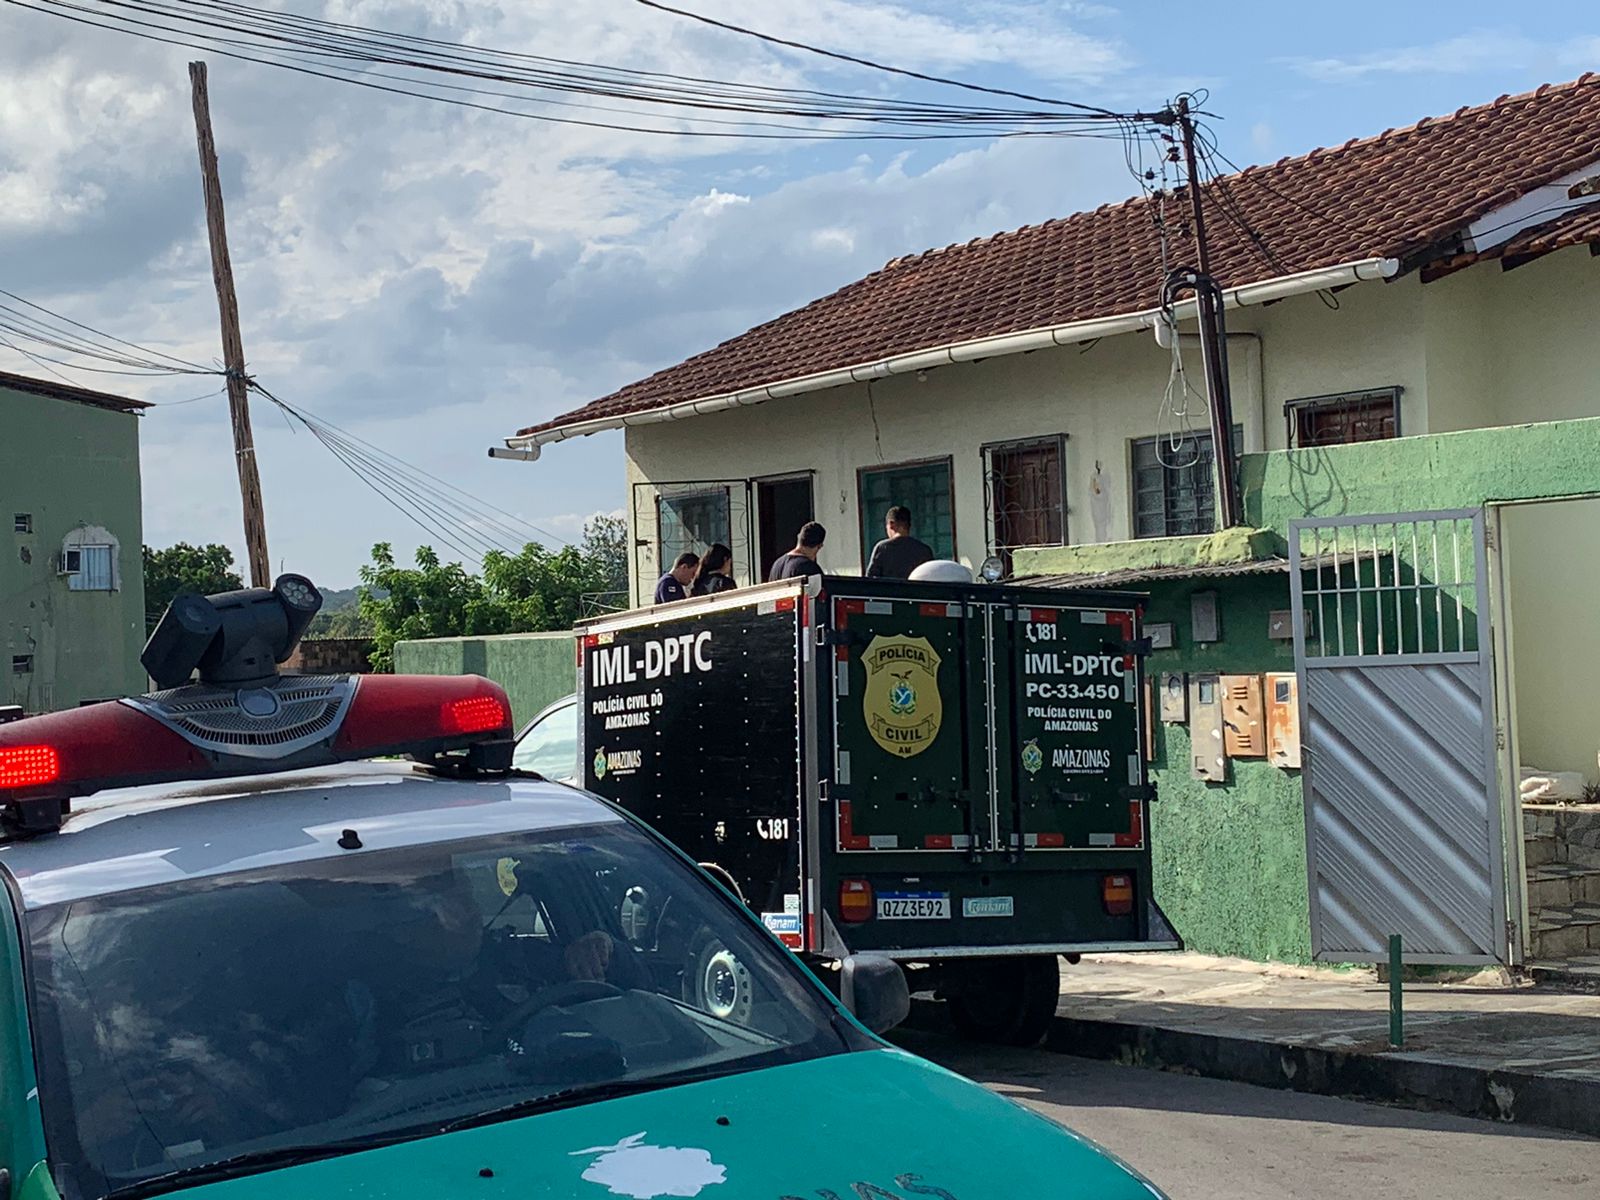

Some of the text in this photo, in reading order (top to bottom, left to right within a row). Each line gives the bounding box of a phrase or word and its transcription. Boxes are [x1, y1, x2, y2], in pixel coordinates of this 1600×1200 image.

[1036, 624, 1057, 640] 181
[592, 630, 713, 687] IML-DPTC
[880, 645, 926, 662] POLÍCIA
[1025, 653, 1124, 677] IML-DPTC
[1026, 682, 1120, 699] PC-33.450
[593, 695, 625, 715] POLÍCIA
[626, 695, 650, 710] CIVIL
[1027, 705, 1112, 720] POLÍCIA CIVIL DO
[605, 711, 650, 730] AMAZONAS
[1044, 720, 1099, 732] AMAZONAS
[886, 728, 922, 740] CIVIL
[898, 746, 912, 754] AM
[1052, 749, 1110, 768] AMAZONAS
[607, 750, 642, 770] AMAZONAS
[767, 819, 788, 839] 181
[883, 900, 943, 917] QZZ3E92
